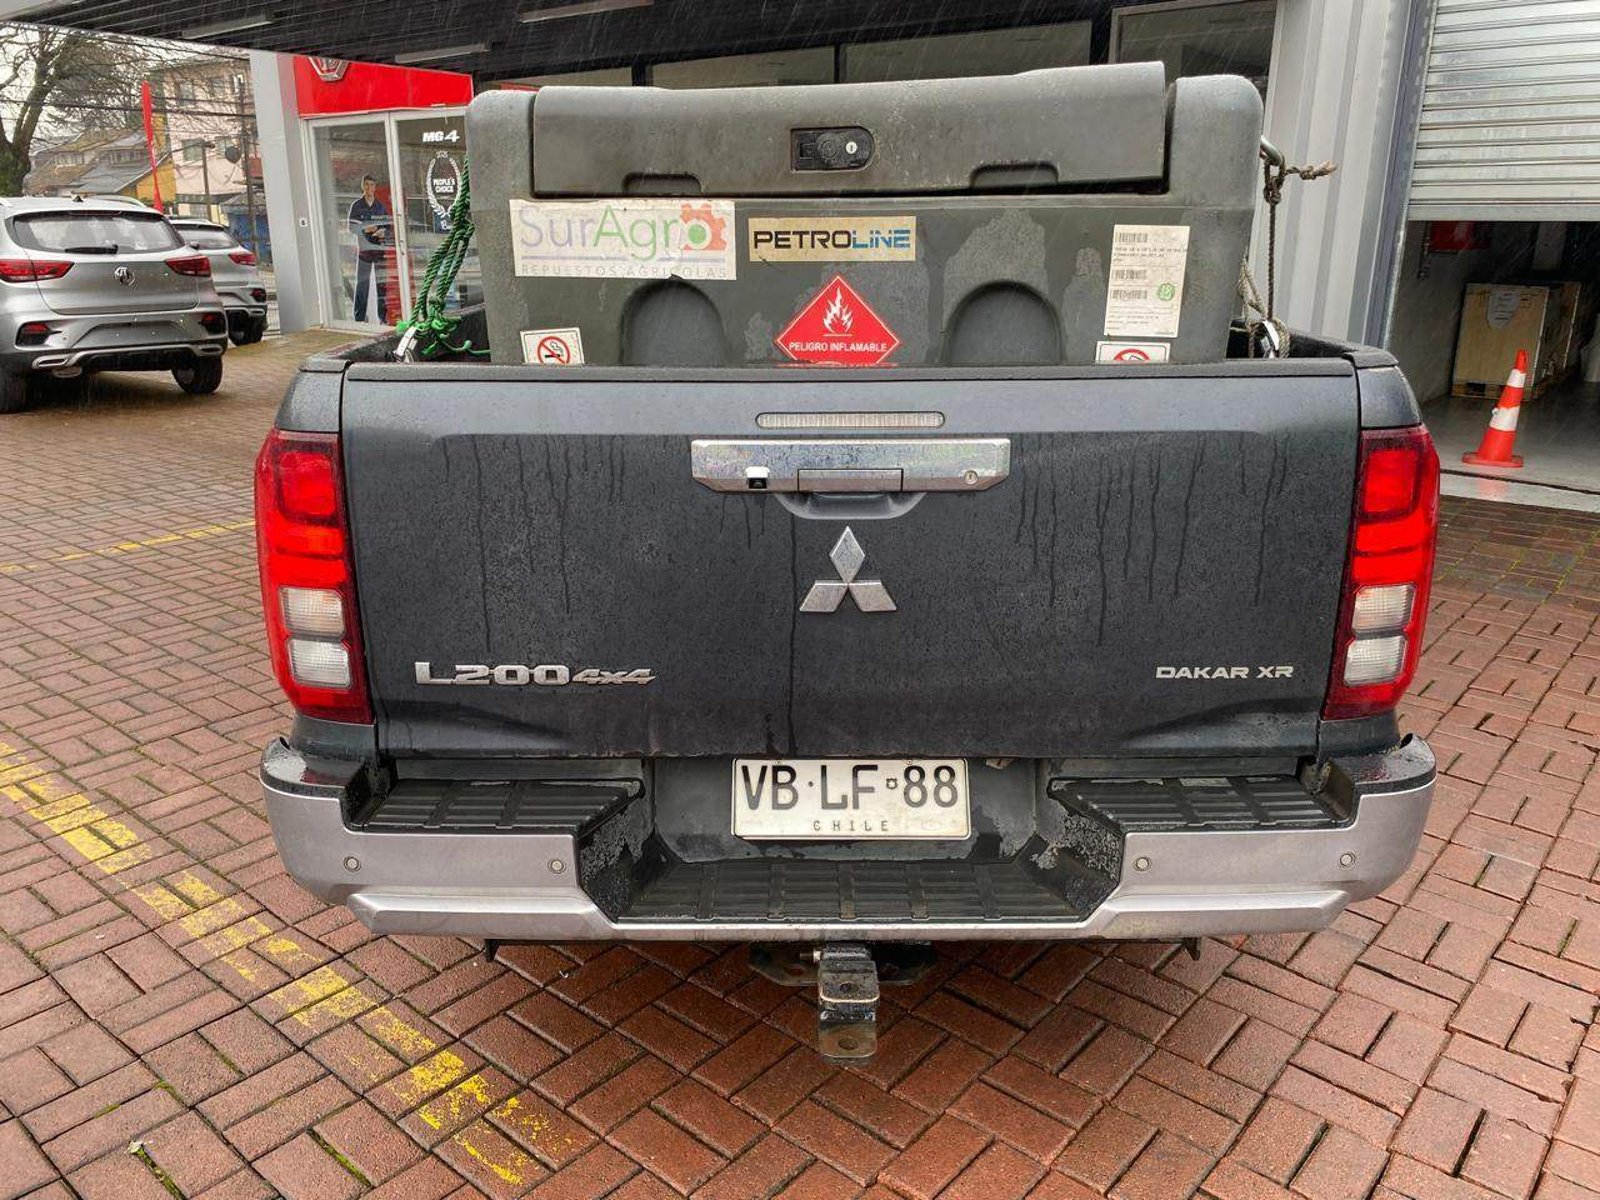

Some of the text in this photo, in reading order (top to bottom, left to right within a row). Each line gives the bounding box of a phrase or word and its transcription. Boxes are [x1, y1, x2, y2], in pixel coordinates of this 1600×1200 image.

[789, 342, 887, 352] PELIGRO INFLAMABLE
[415, 661, 570, 686] L200
[1155, 665, 1295, 679] DAKAR XR
[813, 820, 889, 831] CHILE
